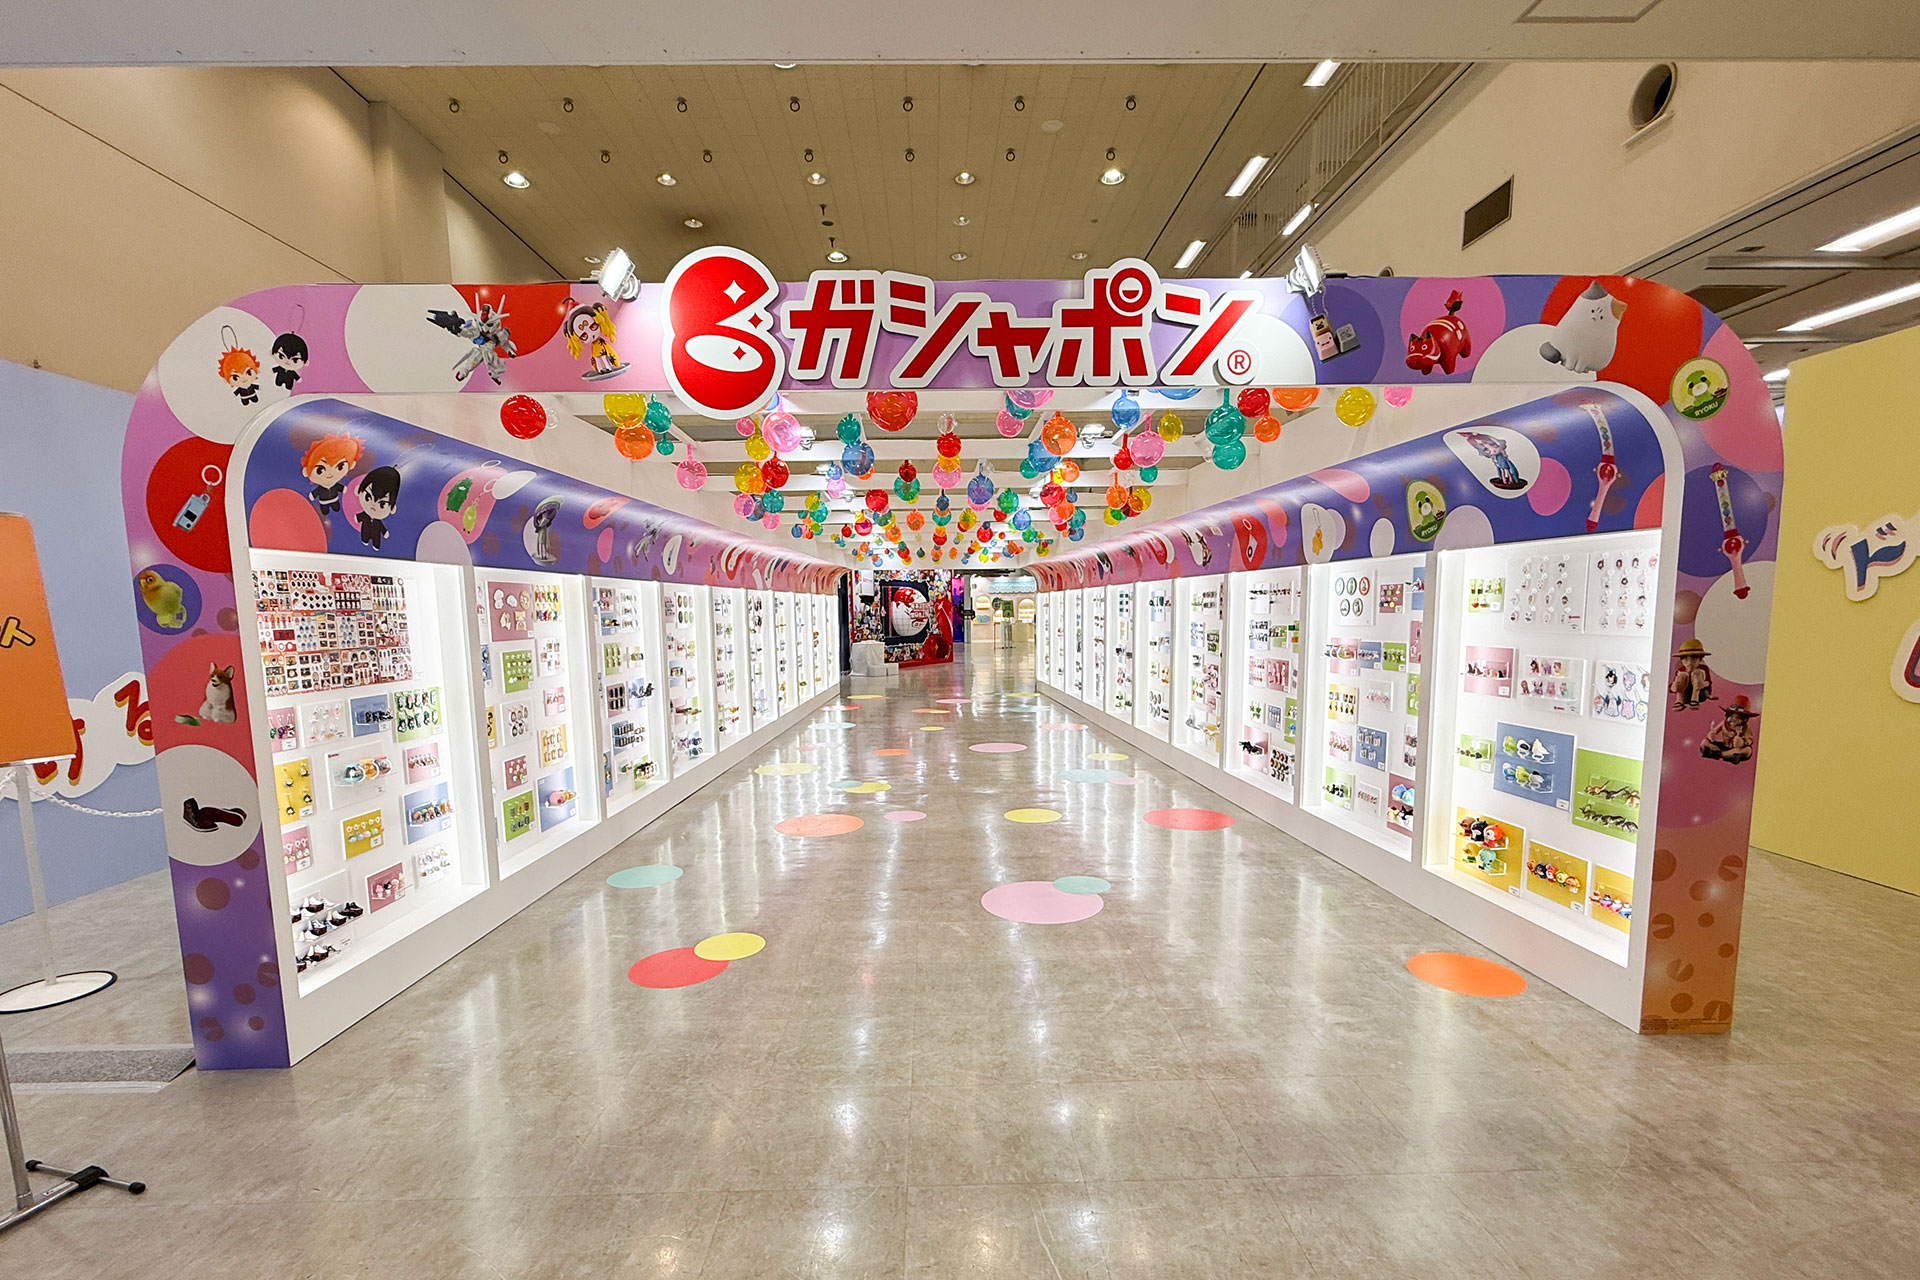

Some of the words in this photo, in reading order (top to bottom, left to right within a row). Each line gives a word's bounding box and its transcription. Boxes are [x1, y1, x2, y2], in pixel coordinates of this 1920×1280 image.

[788, 267, 1254, 379] ガシャポン
[1694, 401, 1719, 416] RYOKU
